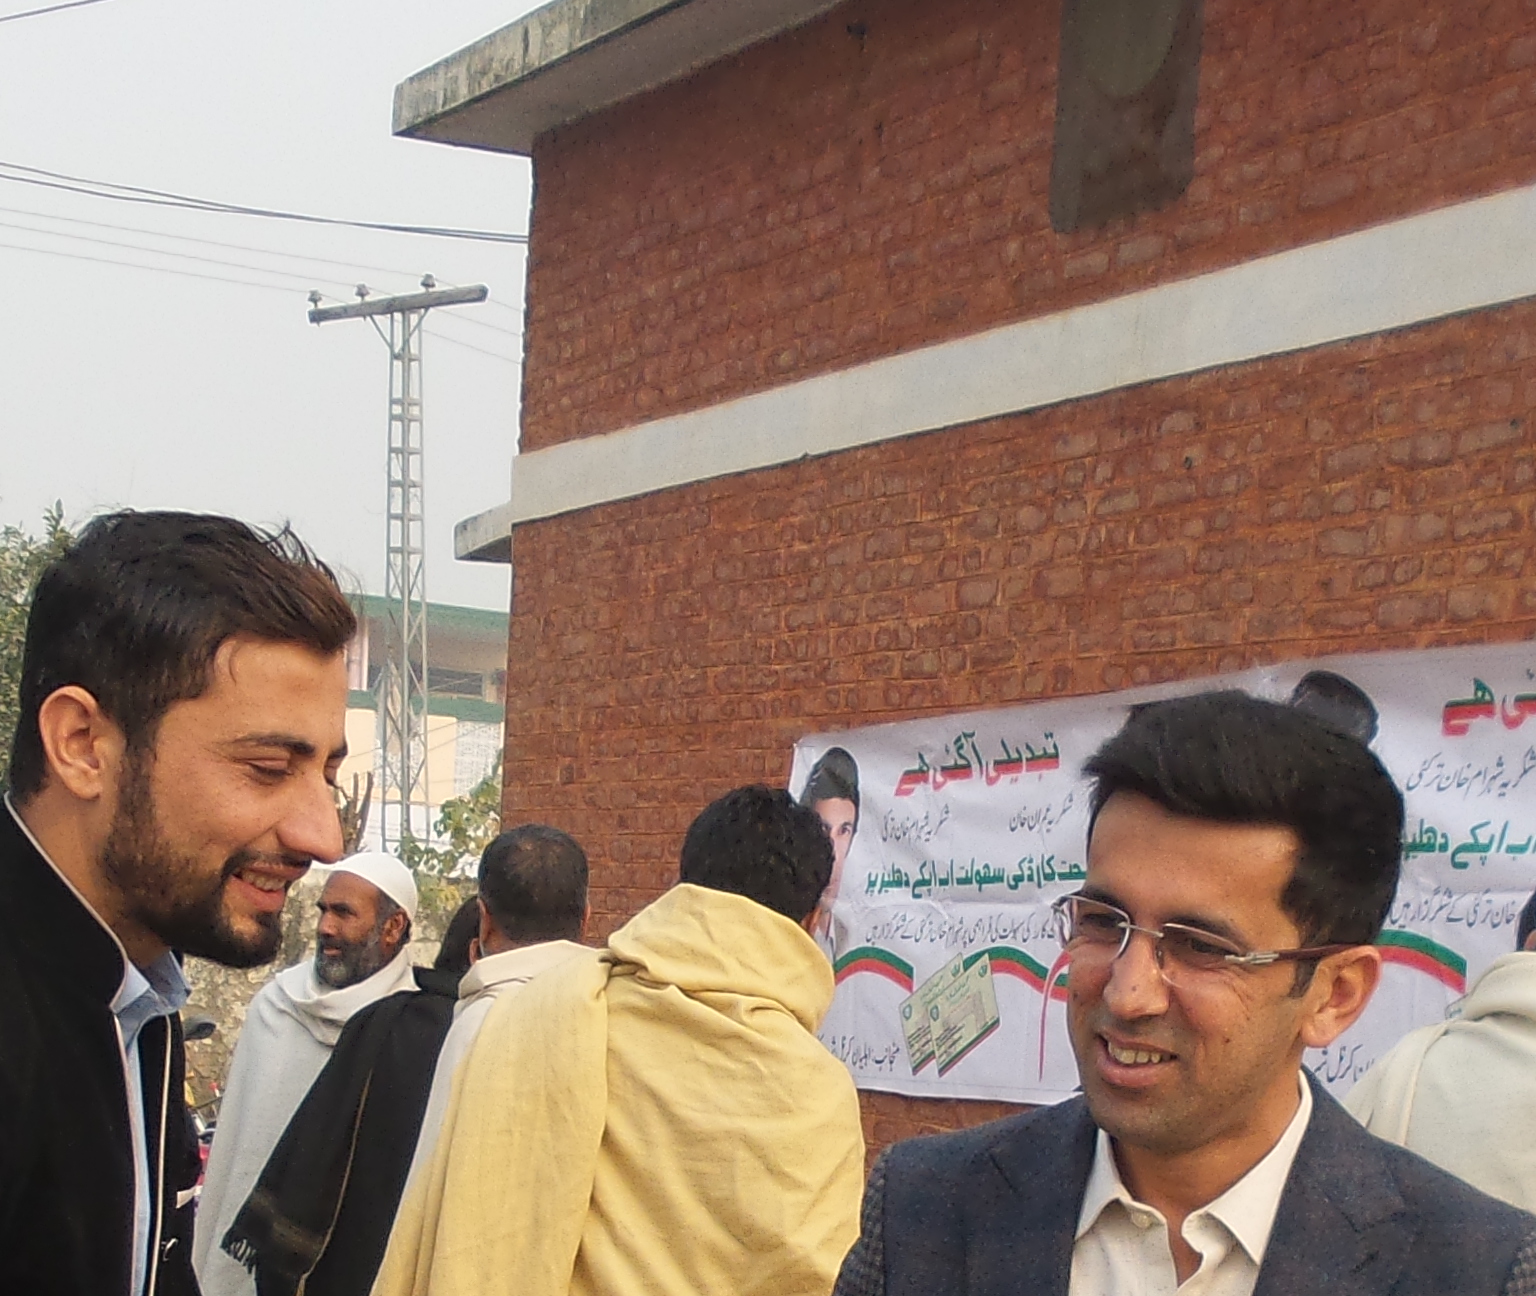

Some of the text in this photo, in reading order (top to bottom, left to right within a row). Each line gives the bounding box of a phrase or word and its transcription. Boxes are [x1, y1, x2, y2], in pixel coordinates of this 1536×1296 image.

[984, 731, 1061, 787] تبدیلی
[1436, 763, 1471, 793] خان
[1006, 856, 1028, 891] کی
[1057, 861, 1087, 882] حت
